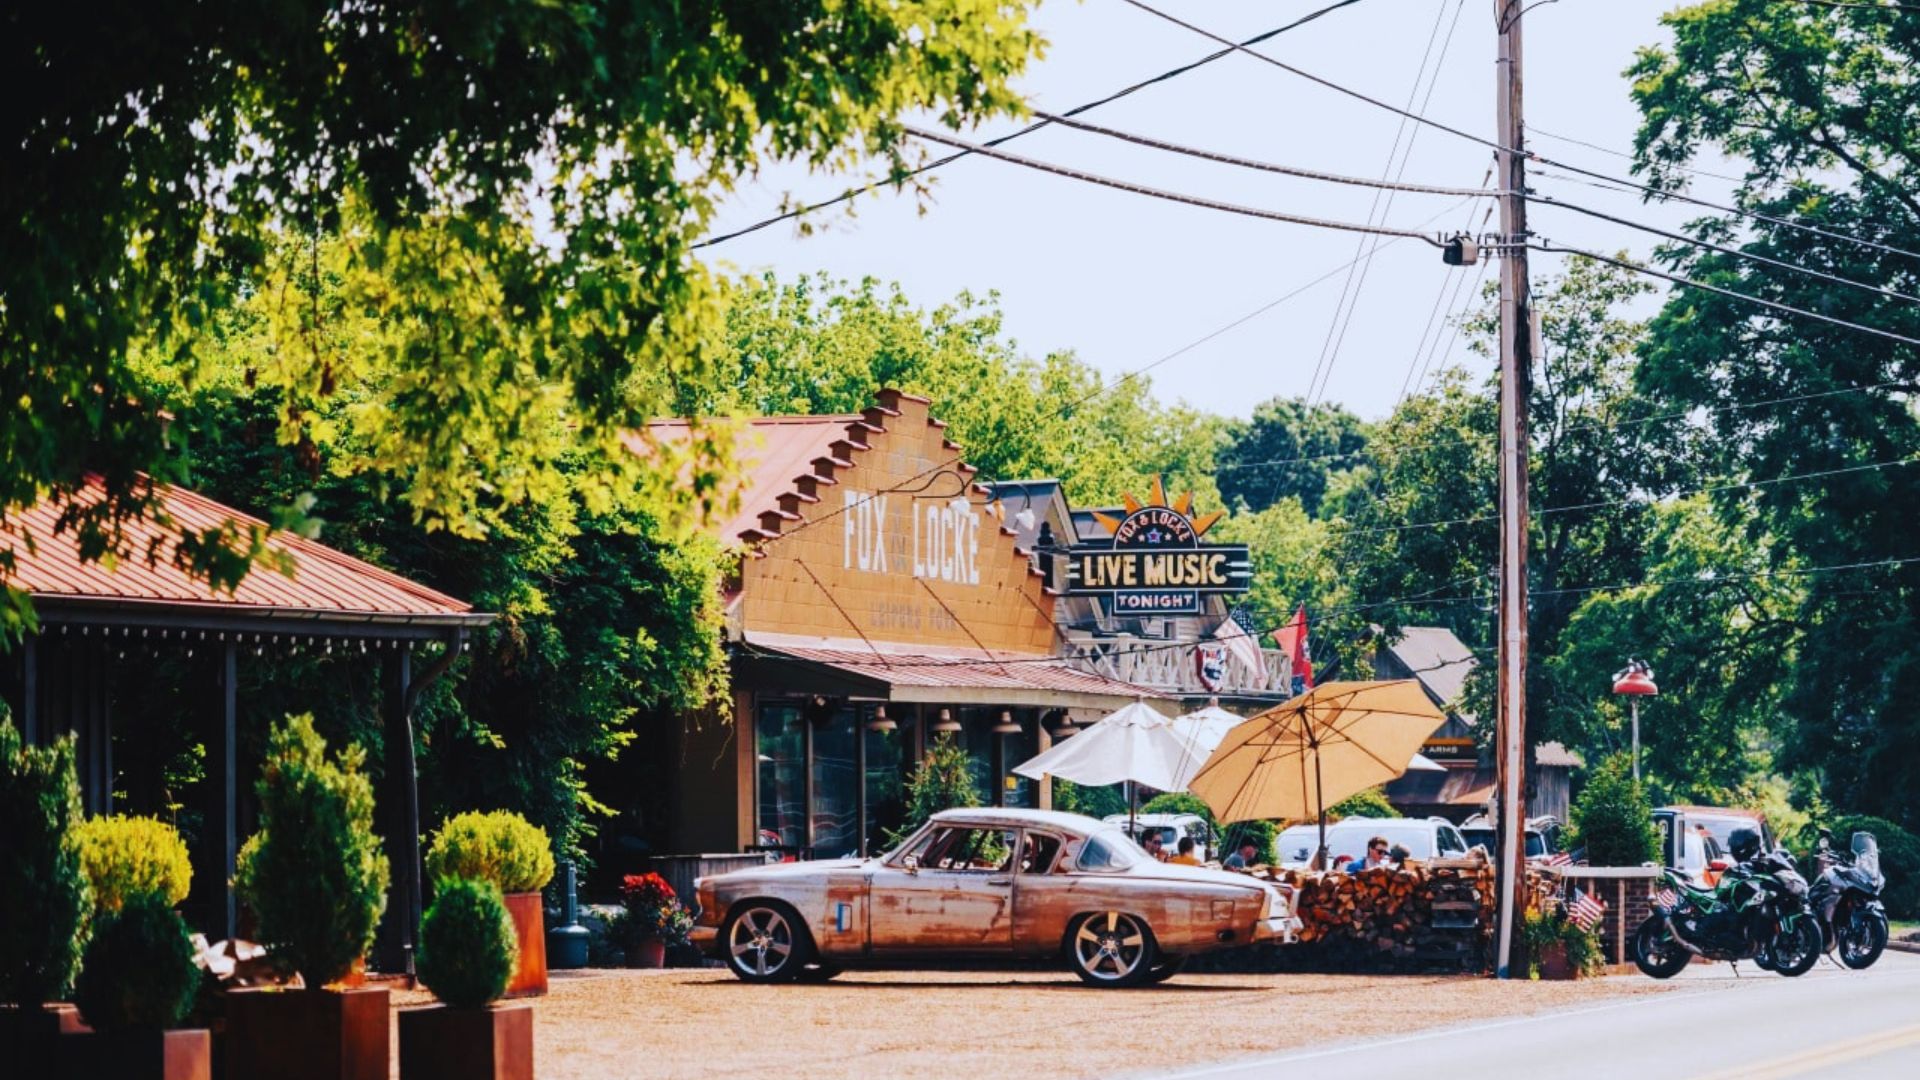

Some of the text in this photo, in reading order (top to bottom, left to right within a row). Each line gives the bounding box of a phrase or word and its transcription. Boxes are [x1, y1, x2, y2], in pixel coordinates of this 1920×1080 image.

[844, 490, 887, 573] FOX
[913, 503, 979, 585] LOCKE
[1118, 511, 1190, 543] FOX & LOCKE
[1083, 554, 1227, 586] LIVE MUSIC
[1118, 595, 1193, 608] TONIGHT
